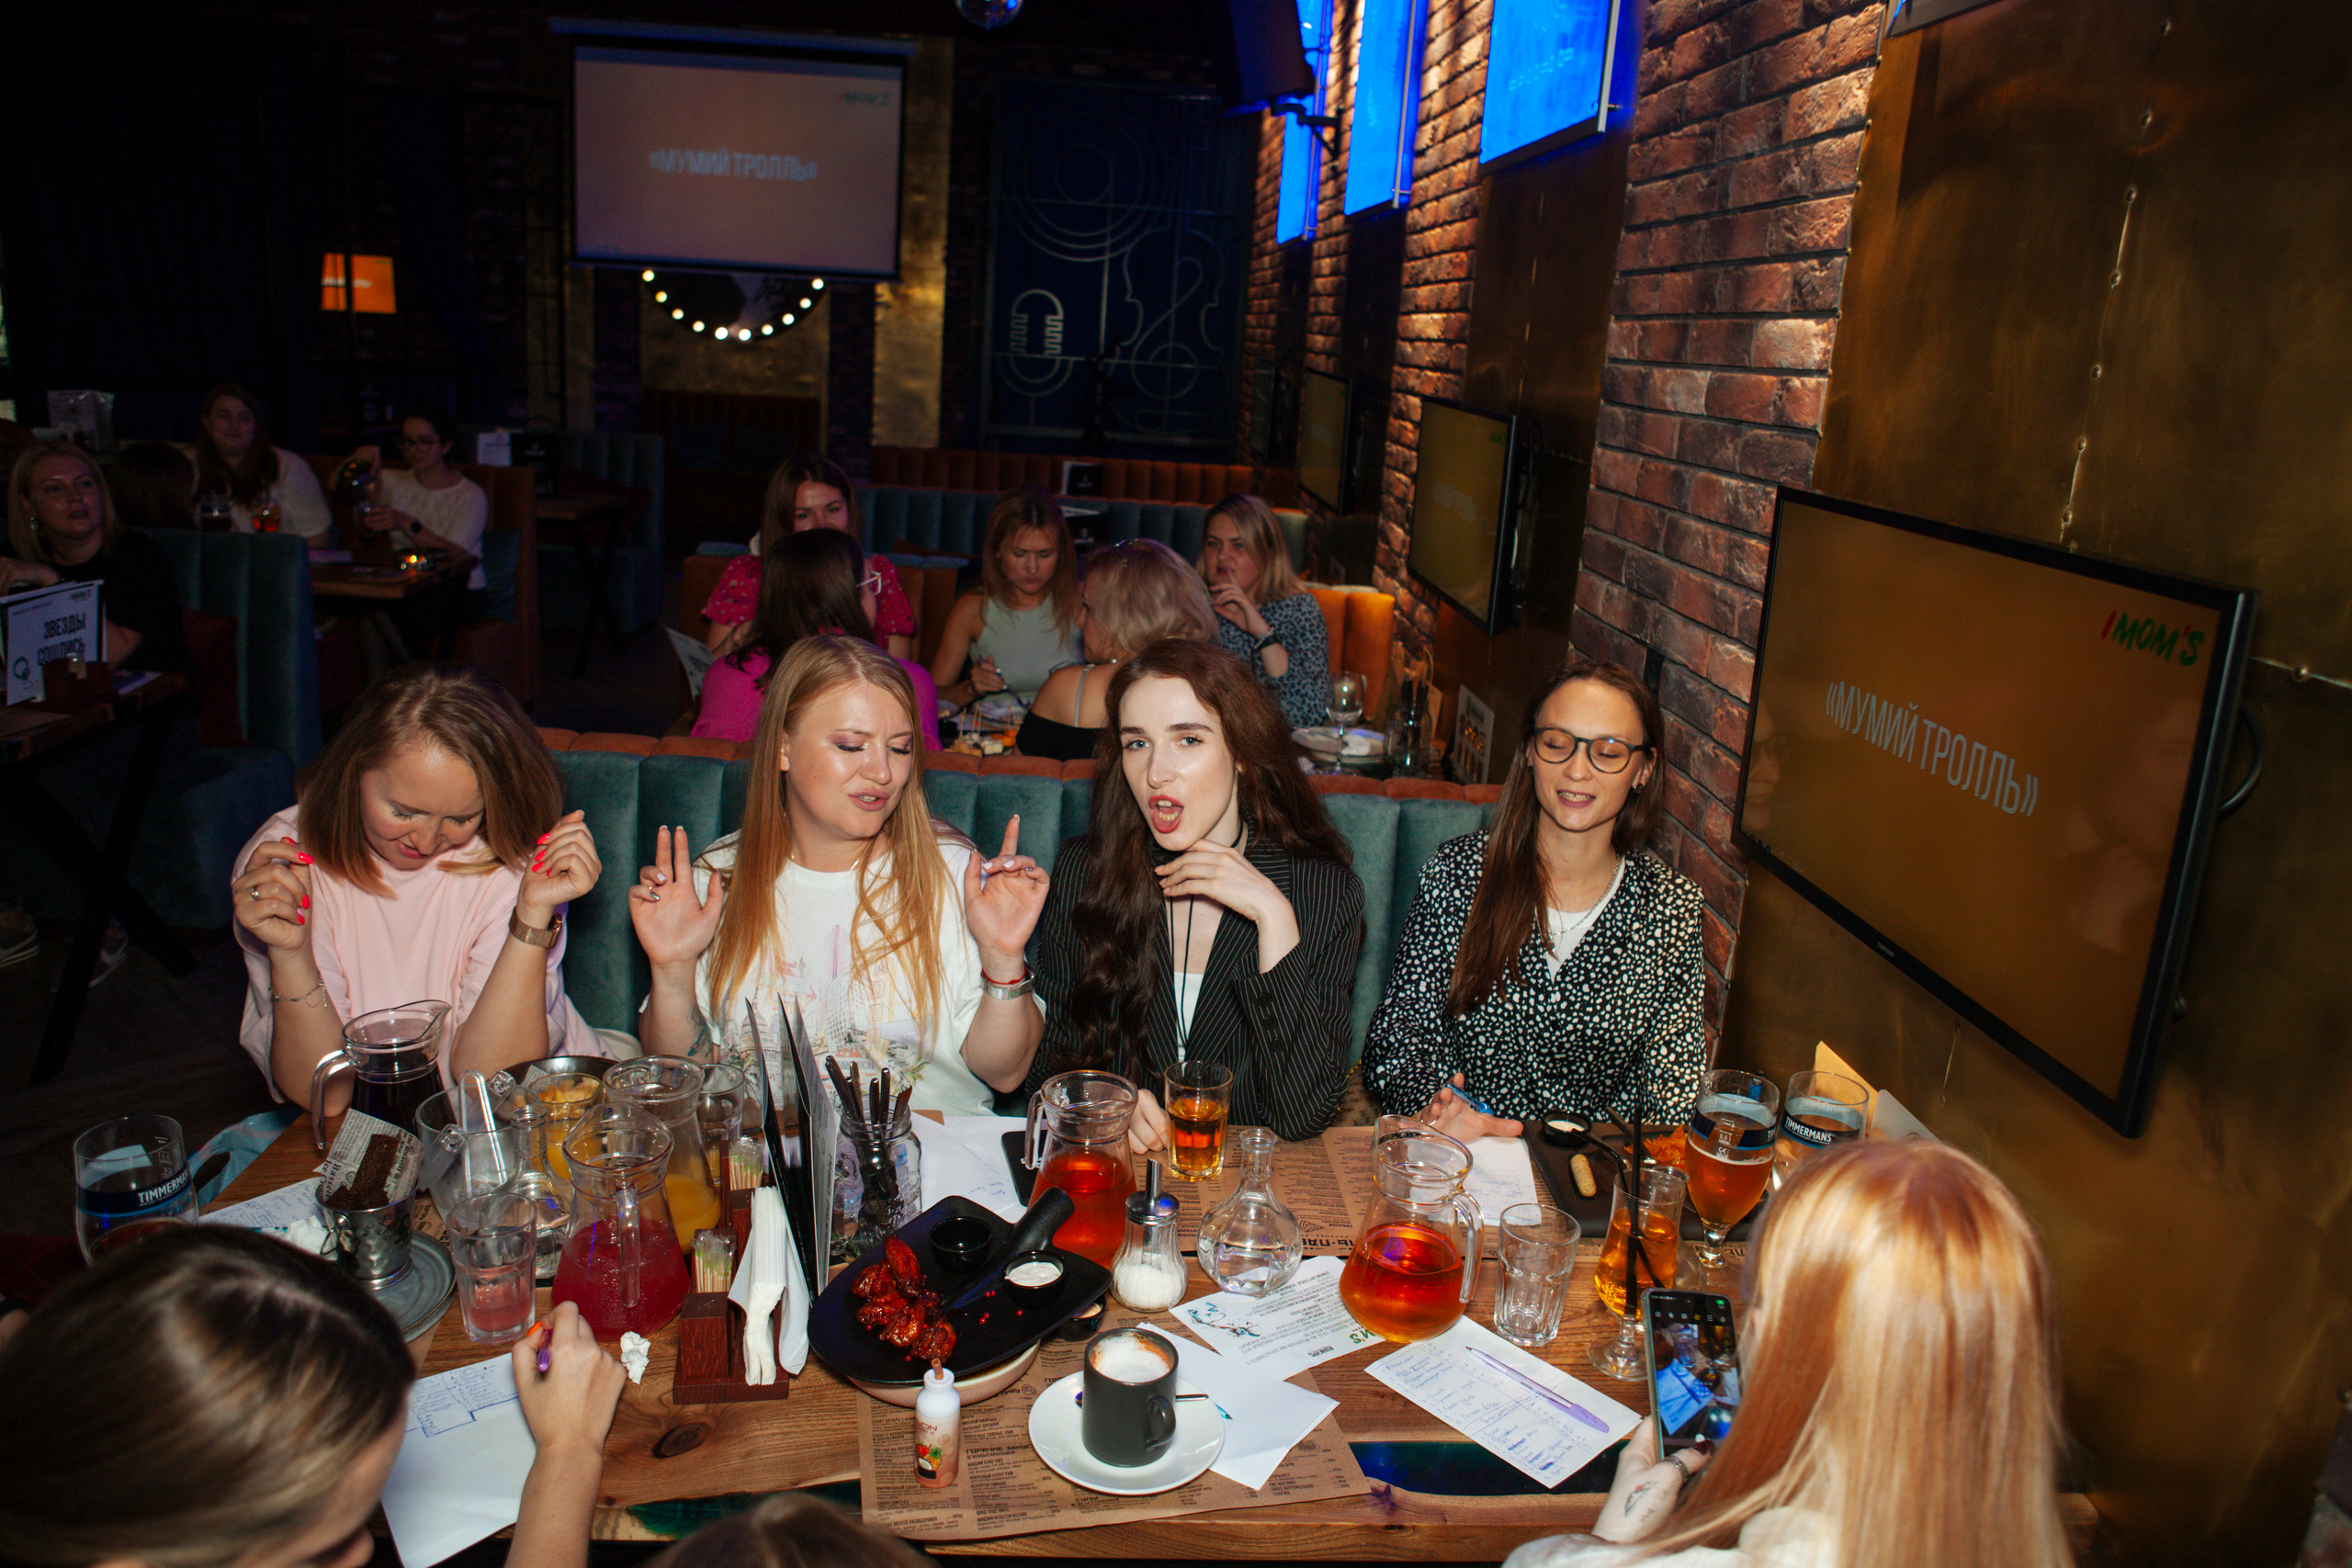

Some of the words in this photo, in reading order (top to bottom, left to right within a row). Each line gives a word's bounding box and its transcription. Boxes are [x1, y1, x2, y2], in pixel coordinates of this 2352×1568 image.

[649, 147, 730, 177] «МУМИЙ
[734, 152, 818, 182] ТРОЛЛЬ»
[43, 613, 86, 639] ЗВЕЗДЫ
[1825, 679, 1917, 764] «МУМИЙ
[1919, 717, 2041, 818] ТРОЛЛЬ»
[1785, 1116, 1833, 1143] TIMMERMANS
[994, 1512, 1028, 1520] КЛАССИЧЕСКИЕ
